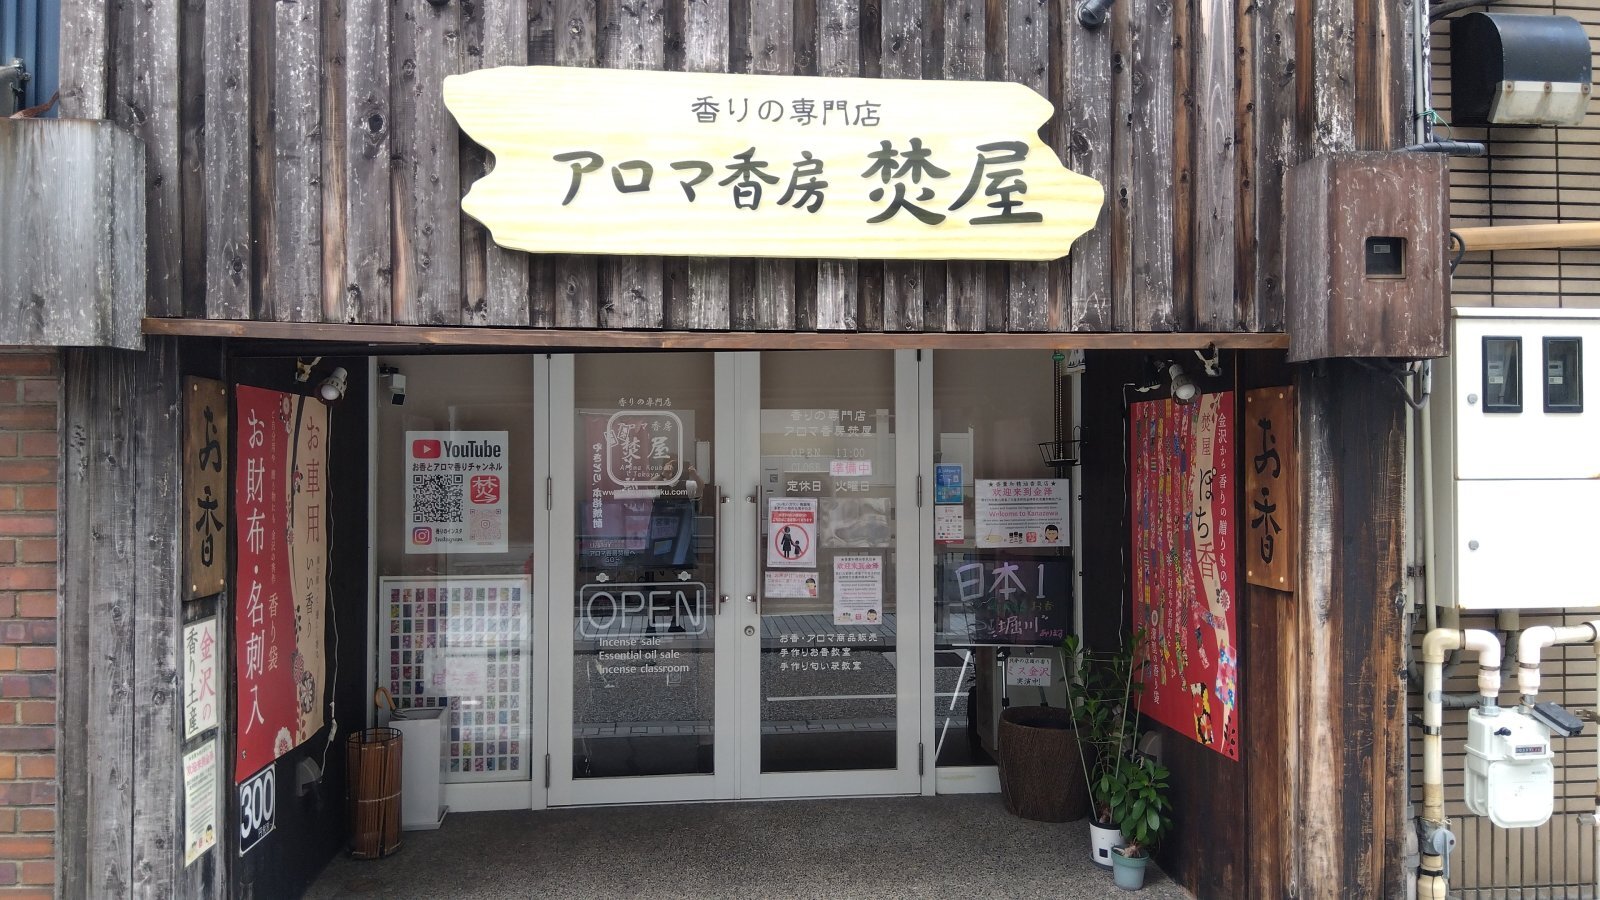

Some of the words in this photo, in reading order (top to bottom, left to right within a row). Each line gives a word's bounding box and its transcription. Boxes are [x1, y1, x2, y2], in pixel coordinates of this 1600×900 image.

[690, 95, 882, 127] 香りの専門店
[553, 146, 829, 213] アロマ香房
[864, 137, 1044, 226] 焚屋
[618, 397, 672, 407] 香りの専門店
[790, 409, 867, 422] 香りの専門店
[443, 440, 502, 458] YouTube
[305, 415, 320, 544] お車用
[412, 462, 503, 472] お香とアロマ香りチャンネル
[832, 461, 870, 474] 準備中
[196, 405, 224, 567] お香
[786, 480, 821, 492] 定休日
[835, 480, 870, 492] 火曜日
[1217, 413, 1229, 583] 金沢から香りの贈りもの
[1251, 417, 1282, 565] お香
[245, 408, 265, 735] お財布・名刺入
[587, 590, 700, 629] OPEN
[600, 637, 637, 646] Incense
[640, 636, 661, 646] sale
[779, 633, 878, 643] お香・アロマ商品販売
[599, 650, 642, 660] Essential
[645, 650, 657, 660] oil
[660, 649, 680, 659] sale
[779, 647, 851, 657] 手作りお香教室
[186, 626, 199, 735] 香り土産
[199, 626, 216, 721] 金沢の
[640, 664, 689, 673] classroom
[241, 770, 273, 839] 300
